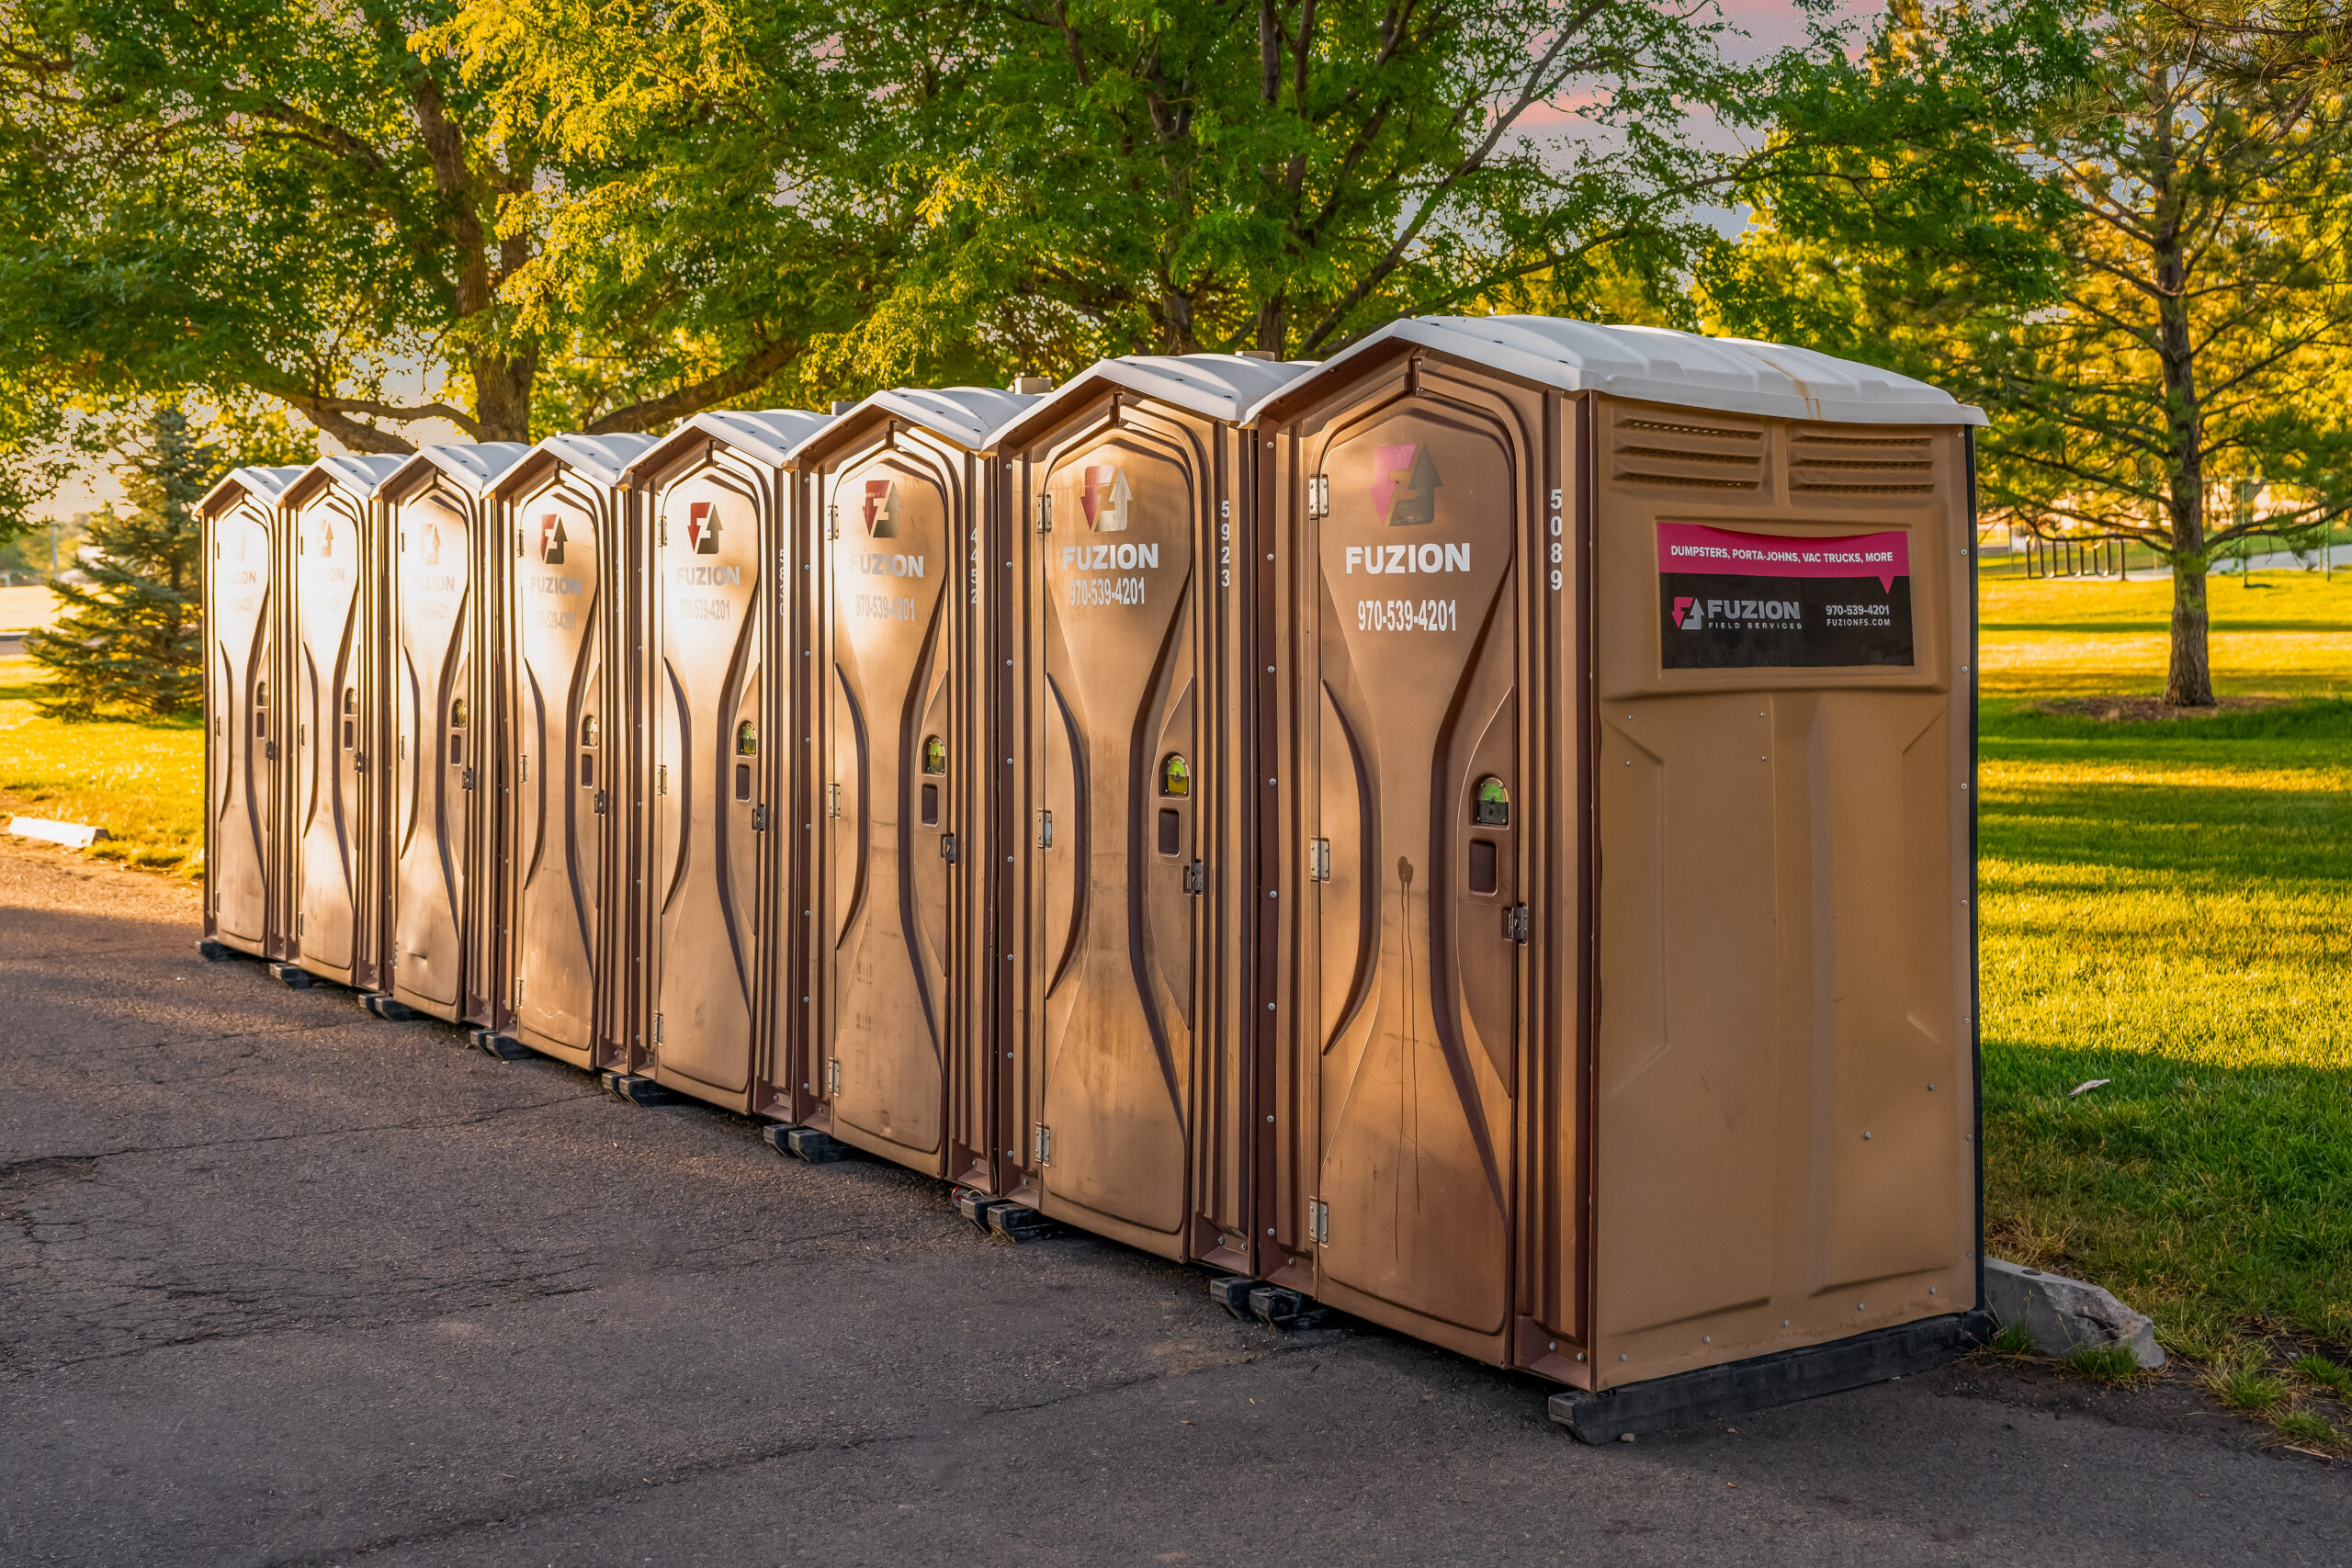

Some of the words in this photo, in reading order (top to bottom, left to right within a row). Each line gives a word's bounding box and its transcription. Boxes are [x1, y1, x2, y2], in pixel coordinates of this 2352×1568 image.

[1220, 500, 1230, 587] 5923
[1550, 489, 1562, 591] 5089
[849, 551, 924, 578] FUZION
[1062, 543, 1159, 571] FUZION
[1346, 542, 1471, 574] FUZION
[1670, 545, 1731, 559] DUMPSTERS,
[1732, 549, 1801, 563] PORTA-JOHNS,
[1803, 552, 1822, 563] VAC
[1823, 553, 1863, 564] TRUCKS,
[1865, 551, 1894, 562] MORE
[530, 575, 582, 595] FUZION
[676, 566, 741, 587] FUZION
[1069, 576, 1146, 606] 970-539-4201
[855, 593, 915, 622] 970-539-4201
[1358, 599, 1456, 632] 970-539-4201
[1707, 600, 1801, 620] FUZION
[1826, 604, 1890, 615] 970-539-4201
[1747, 622, 1803, 630] SERVICES
[1826, 618, 1891, 627] FUZIONFS.COM
